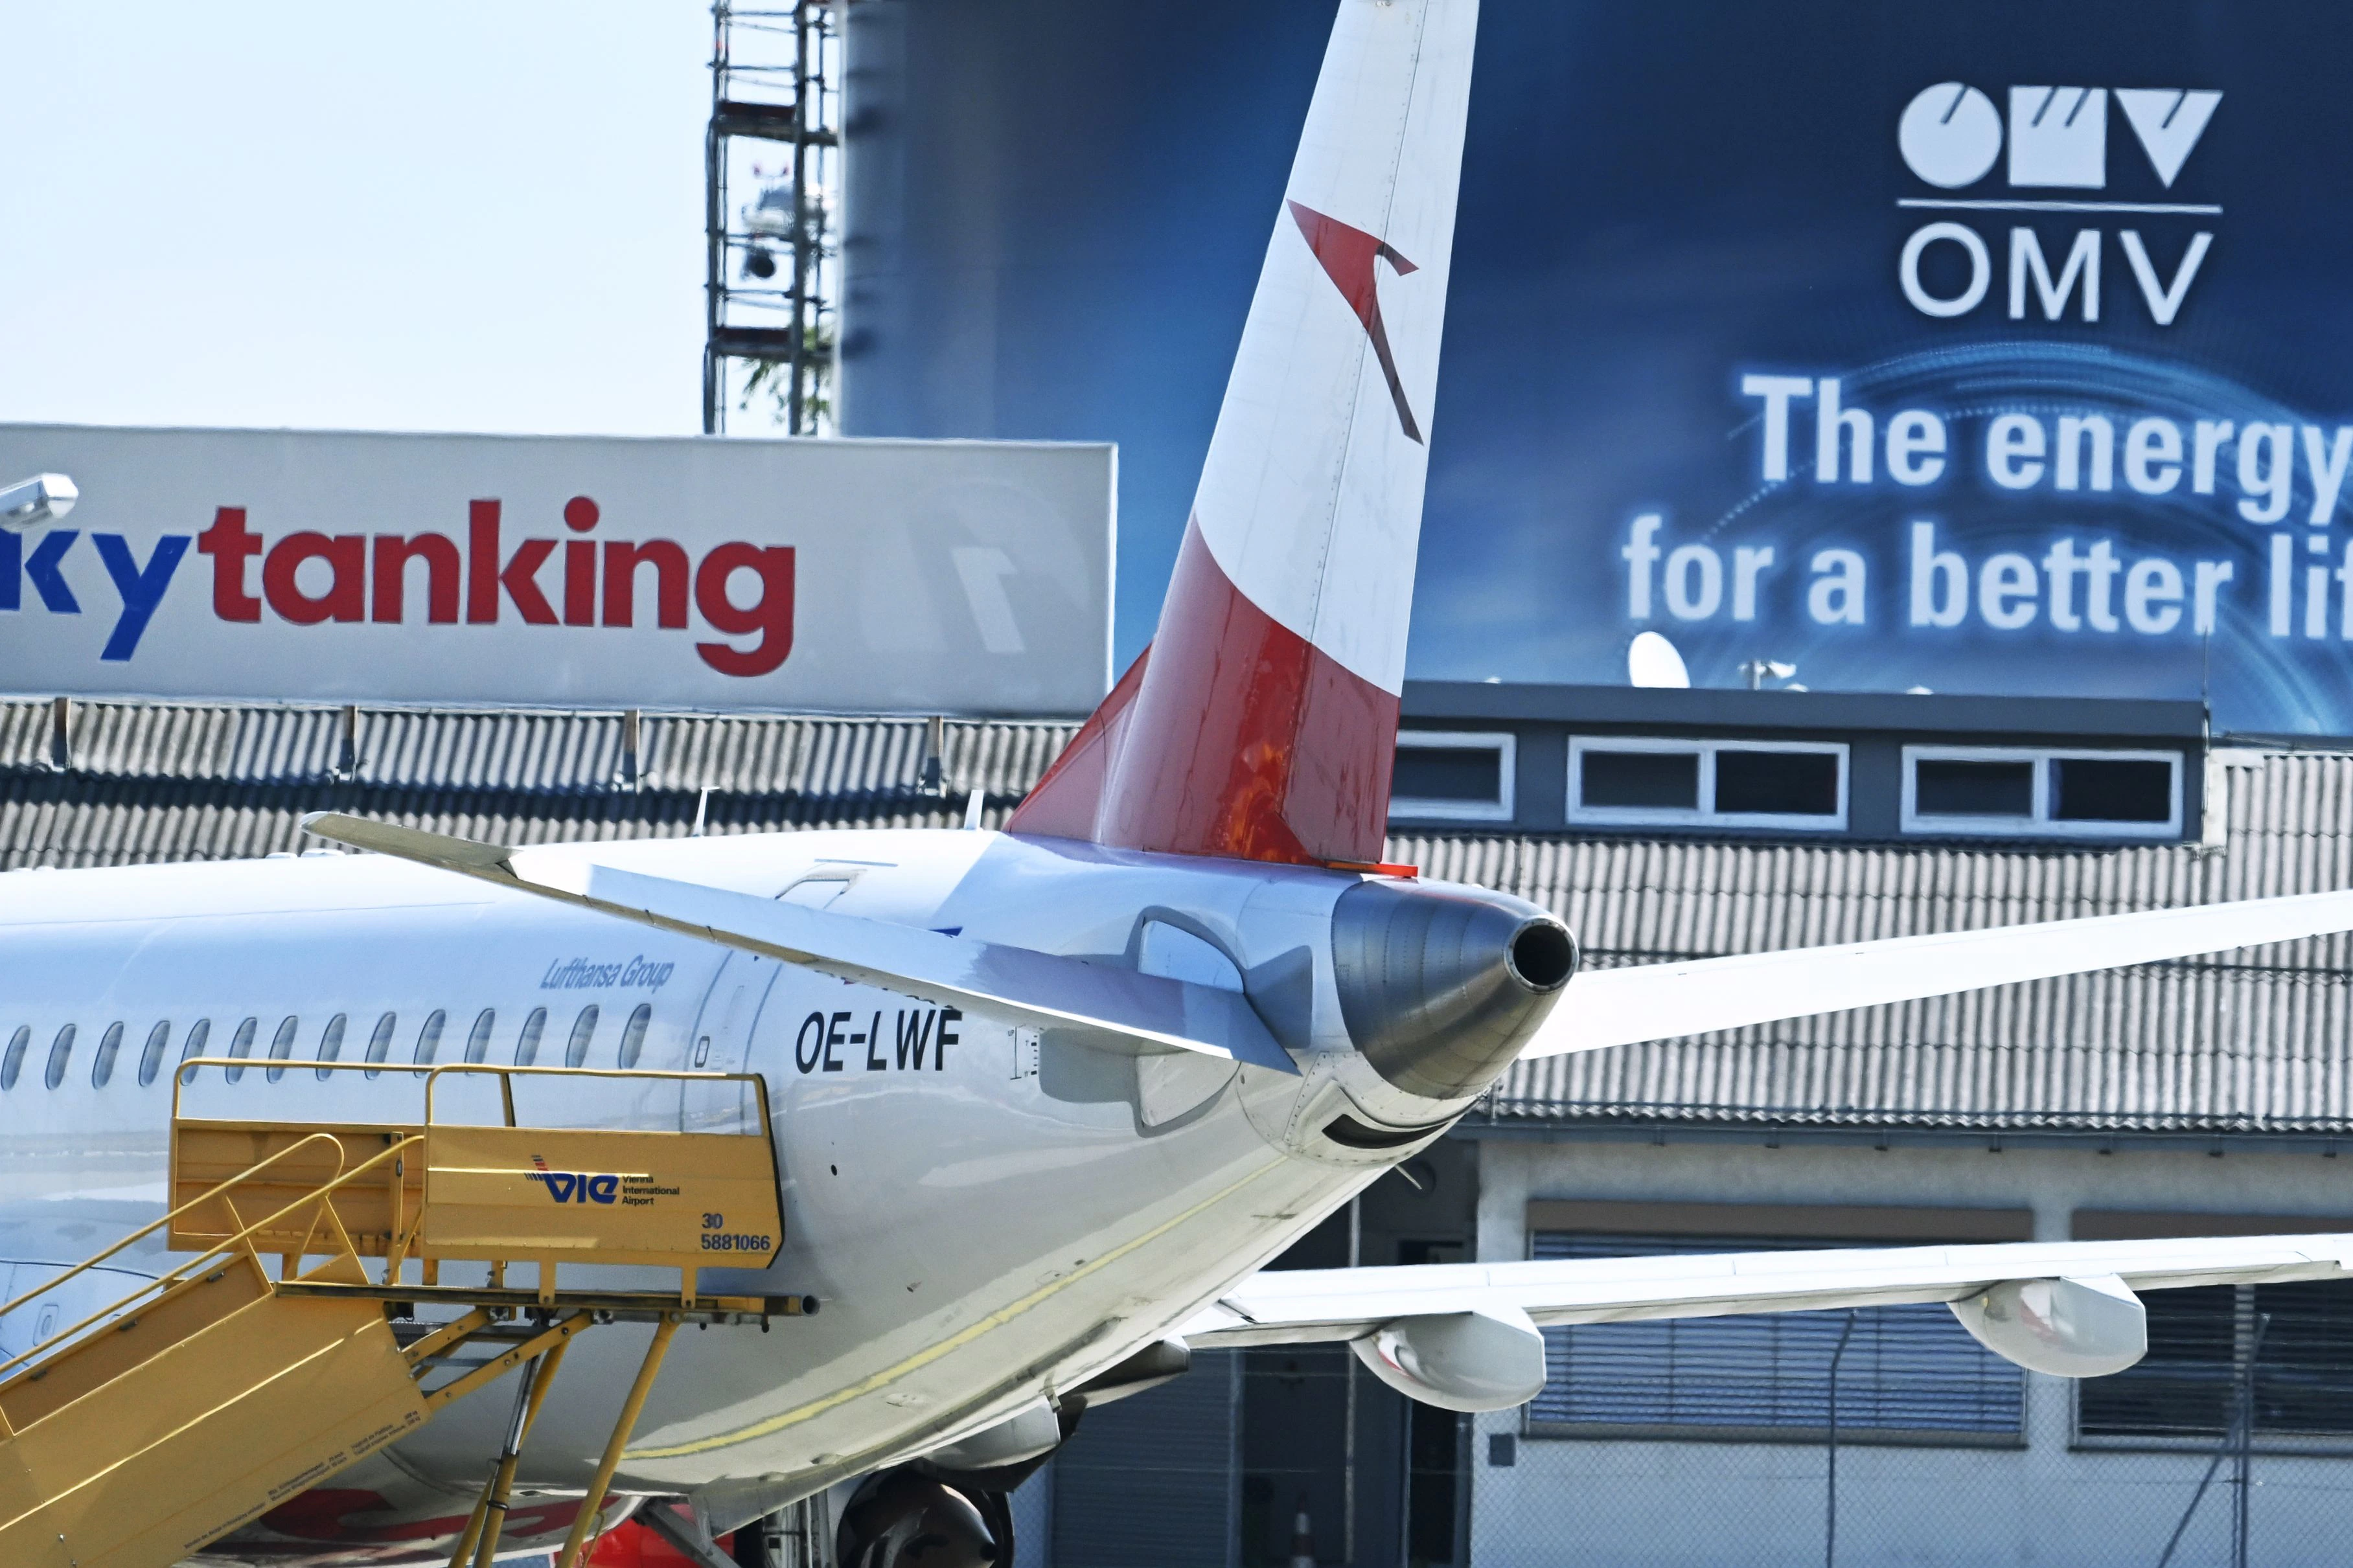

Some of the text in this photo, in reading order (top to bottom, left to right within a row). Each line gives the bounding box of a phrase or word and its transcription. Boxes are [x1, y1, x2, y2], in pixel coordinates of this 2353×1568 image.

[1899, 221, 2214, 326] OMV
[1742, 374, 2353, 527] The energy
[1622, 514, 1774, 620] for
[1808, 546, 1865, 625] a
[1909, 521, 2234, 635] better
[540, 954, 674, 994] Lufthansa Group
[796, 1008, 964, 1075] OE-LWF
[623, 1176, 654, 1184] Vienna
[623, 1185, 680, 1195] International
[622, 1196, 654, 1207] Airport
[702, 1212, 723, 1229] 30
[701, 1233, 770, 1250] 5881066
